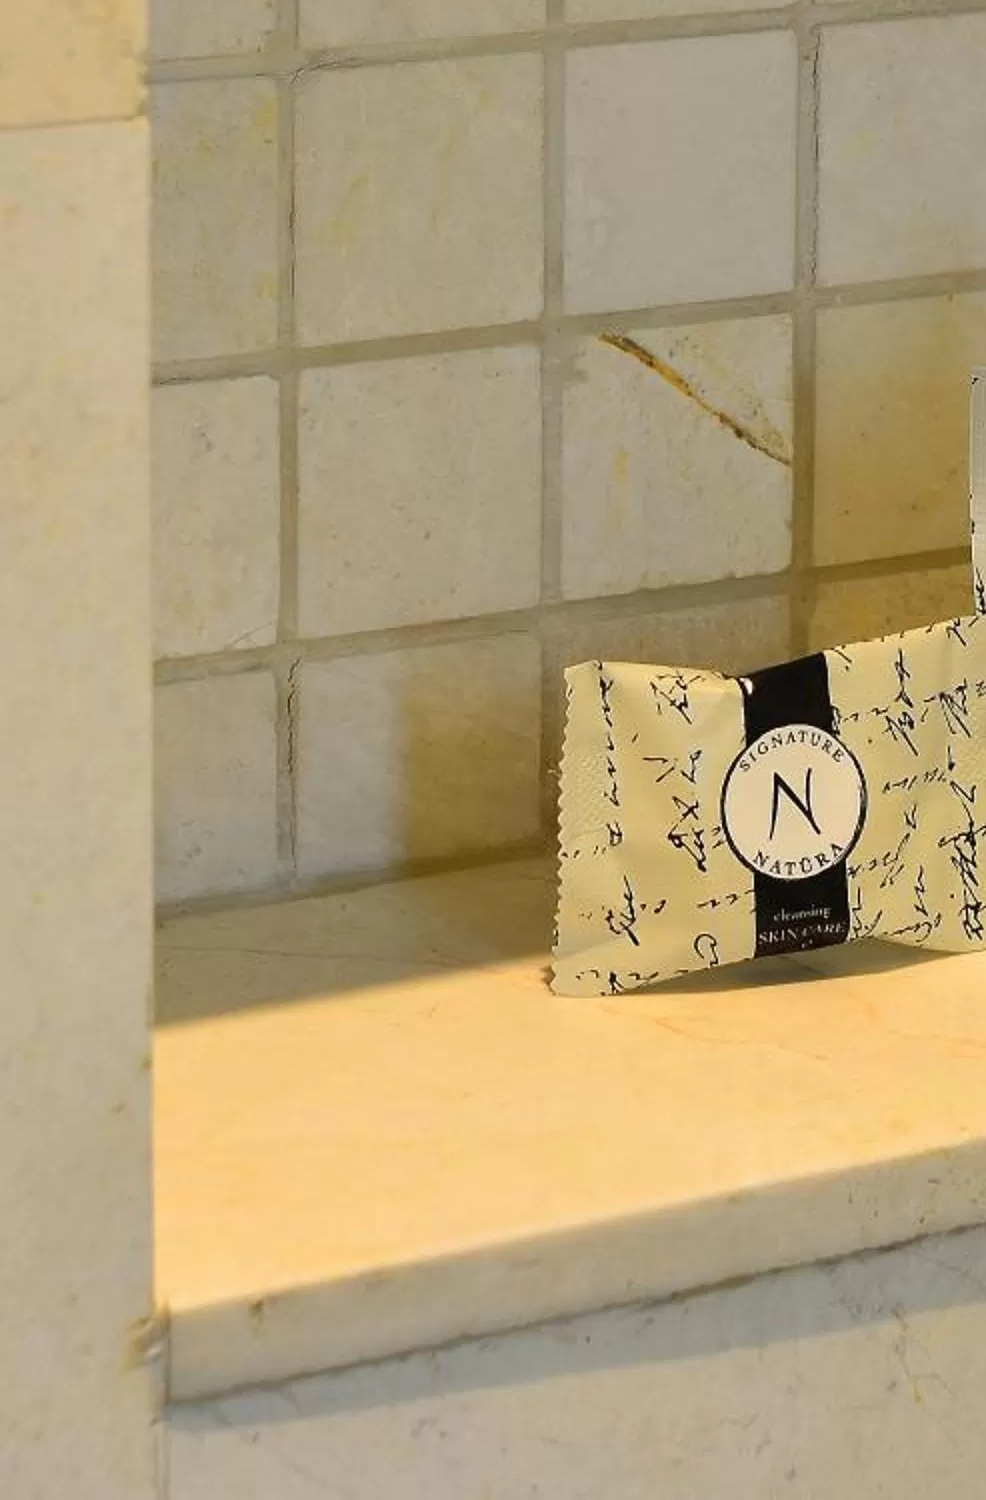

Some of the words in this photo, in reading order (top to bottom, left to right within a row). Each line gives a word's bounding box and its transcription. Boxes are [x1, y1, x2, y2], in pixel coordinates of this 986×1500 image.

[739, 729, 845, 773] SIGNATURE
[769, 767, 821, 841] N
[773, 903, 832, 921] cleansing
[758, 927, 799, 945] SKIN
